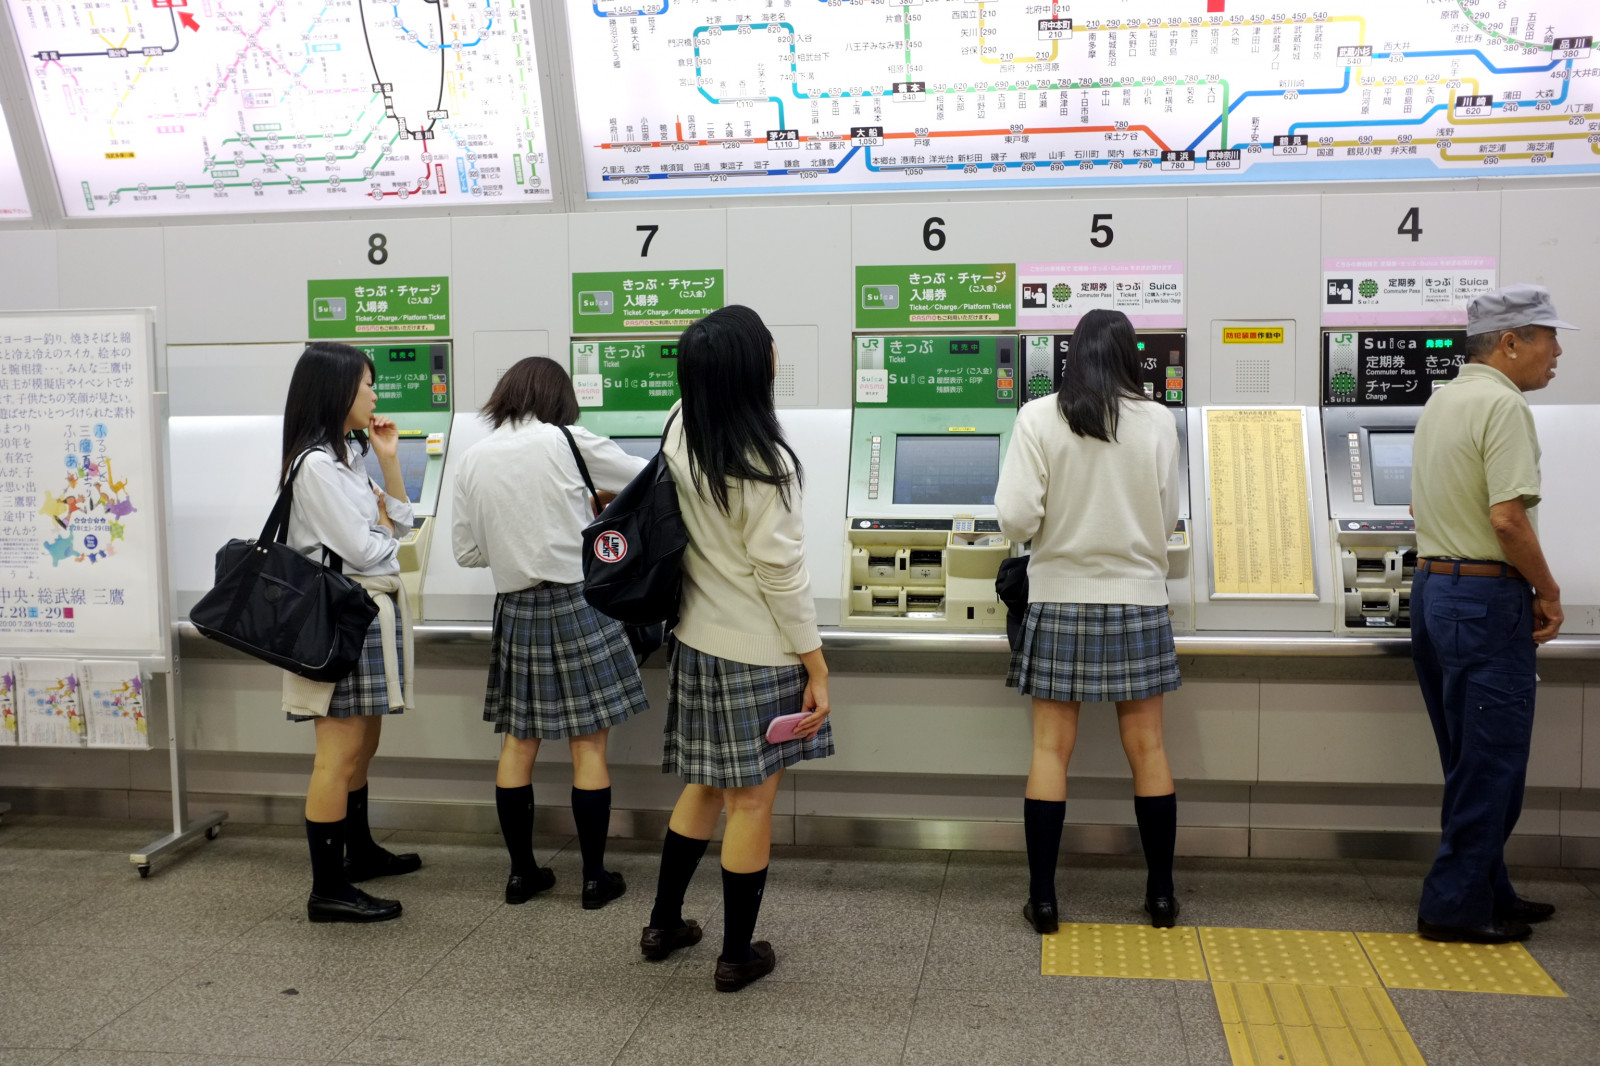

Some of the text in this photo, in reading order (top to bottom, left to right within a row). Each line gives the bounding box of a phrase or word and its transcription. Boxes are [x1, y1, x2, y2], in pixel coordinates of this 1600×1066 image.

[1025, 5, 1051, 14] 北府中
[1559, 39, 1585, 49] 品川
[1025, 63, 1060, 72] 分倍河原
[1536, 89, 1555, 98] 大森
[1465, 107, 1481, 115] 620
[856, 128, 878, 137] 大船
[1010, 124, 1024, 132] 890
[1004, 136, 1029, 144] 東戸塚
[1104, 132, 1138, 141] 保土ケ谷
[774, 141, 793, 149] 1,110
[829, 141, 846, 150] 藤沢
[858, 138, 877, 146] 1,050
[913, 138, 931, 147] 戸塚
[1020, 152, 1036, 160] 根岸
[1074, 150, 1099, 159] 石川町
[1133, 148, 1158, 157] 桜木町
[872, 156, 897, 165] 本郷台
[900, 155, 925, 164] 港南台
[929, 155, 954, 163] 洋光台
[958, 153, 983, 162] 新杉田
[719, 161, 744, 170] 東逗子
[784, 159, 800, 168] 鎌倉
[810, 158, 835, 167] 北鎌倉
[602, 166, 625, 174] 久里浜
[660, 163, 684, 172] 横須賀
[1397, 207, 1423, 242] 4
[923, 216, 946, 251] 6
[1090, 214, 1114, 248] 5
[636, 225, 659, 257] 7
[367, 233, 388, 265] 8
[908, 271, 1006, 285] きっぷ・チャージ
[1389, 278, 1416, 287] 定期券
[1425, 278, 1451, 287] きっぷ
[1460, 278, 1489, 286] Suica
[622, 277, 715, 291] きっぷ・チャージ
[1081, 282, 1107, 291] 定期券
[1116, 282, 1141, 291] きっぷ
[1149, 282, 1177, 290] Suica
[354, 284, 441, 297] きっぷ・チャージ
[910, 288, 947, 301] 入場券
[624, 294, 659, 307] 入場券
[355, 301, 388, 313] 入場券
[1031, 337, 1048, 346] JR
[1335, 334, 1352, 343] JR
[862, 339, 879, 348] JR
[889, 340, 934, 354] きっぷ
[1364, 338, 1417, 349] Suica
[1426, 339, 1453, 348] 発売中
[578, 344, 594, 354] JR
[604, 344, 646, 359] きっぷ
[889, 355, 906, 363] Ticket
[1366, 355, 1405, 368] 定期券
[1426, 355, 1465, 367] きっぷ
[603, 378, 648, 388] Suica
[889, 373, 935, 384] Suica
[1366, 380, 1418, 393] チャージ
[0, 423, 30, 434] まつり
[93, 588, 124, 605] 三鷹
